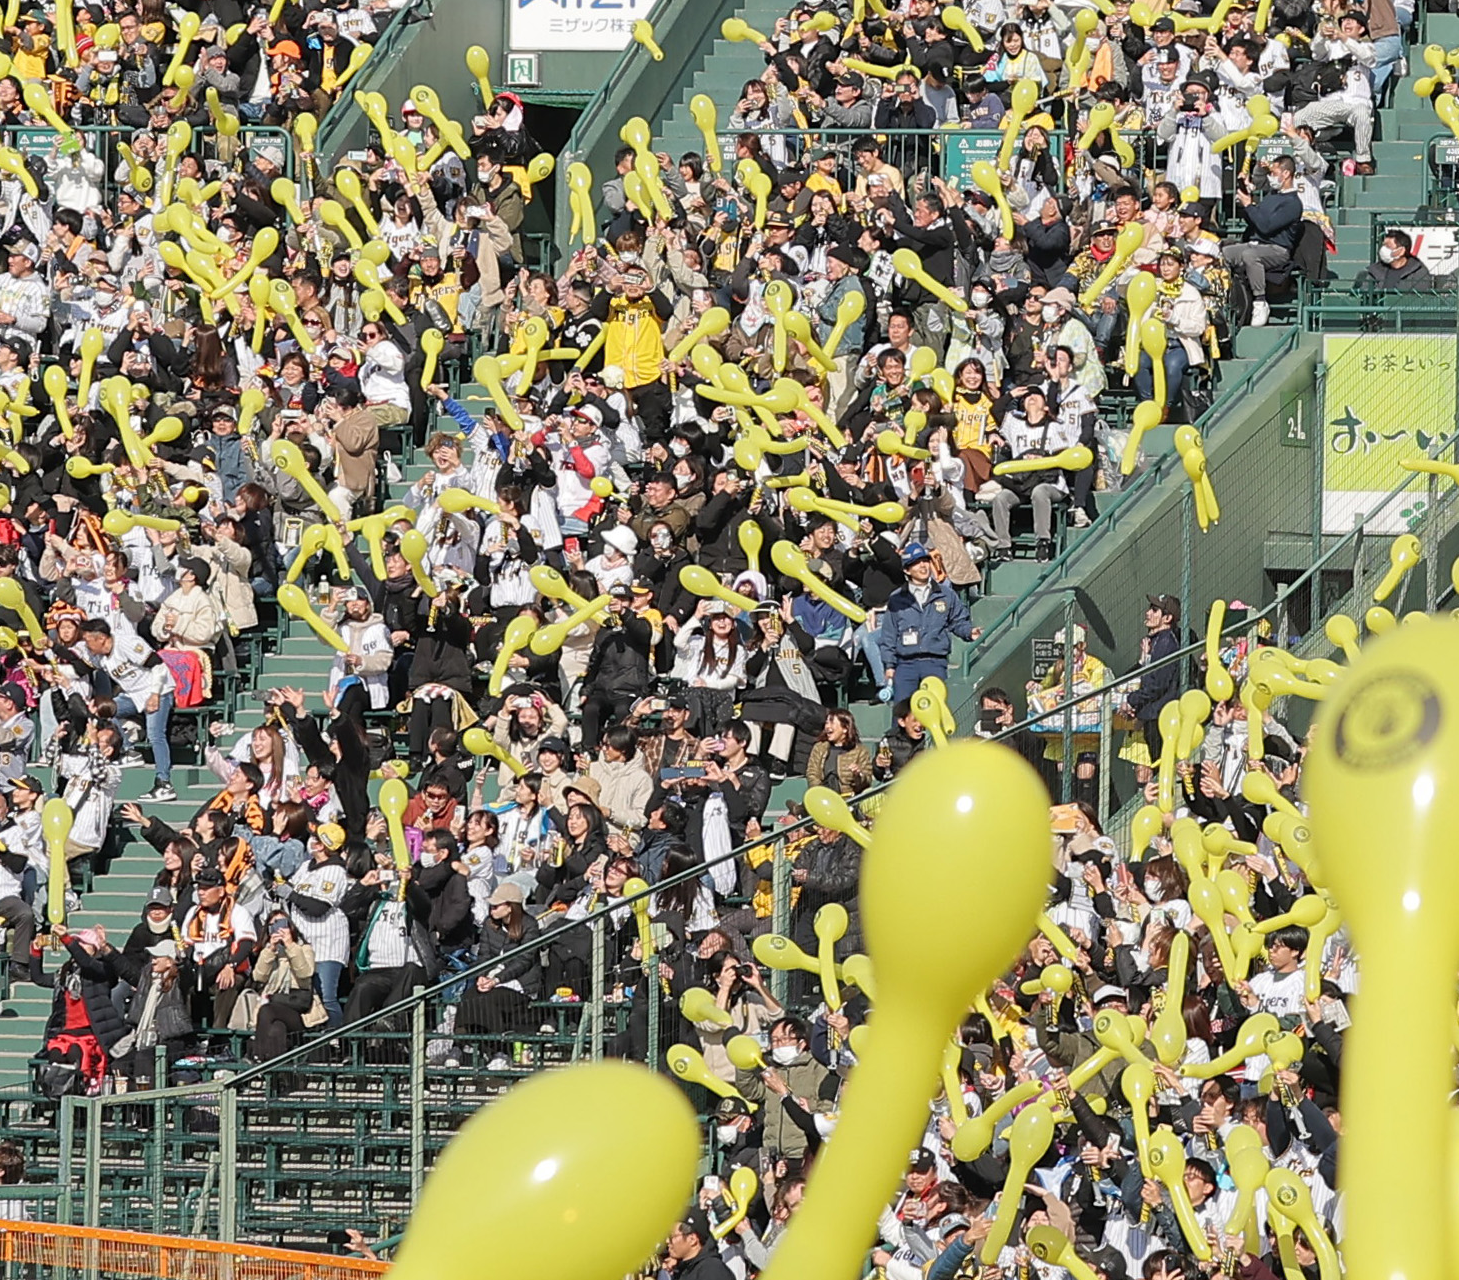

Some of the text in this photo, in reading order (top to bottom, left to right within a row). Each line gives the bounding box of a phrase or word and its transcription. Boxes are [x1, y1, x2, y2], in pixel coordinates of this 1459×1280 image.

[1043, 38, 1052, 48] 8
[1068, 413, 1076, 424] 5
[792, 663, 802, 675] 5
